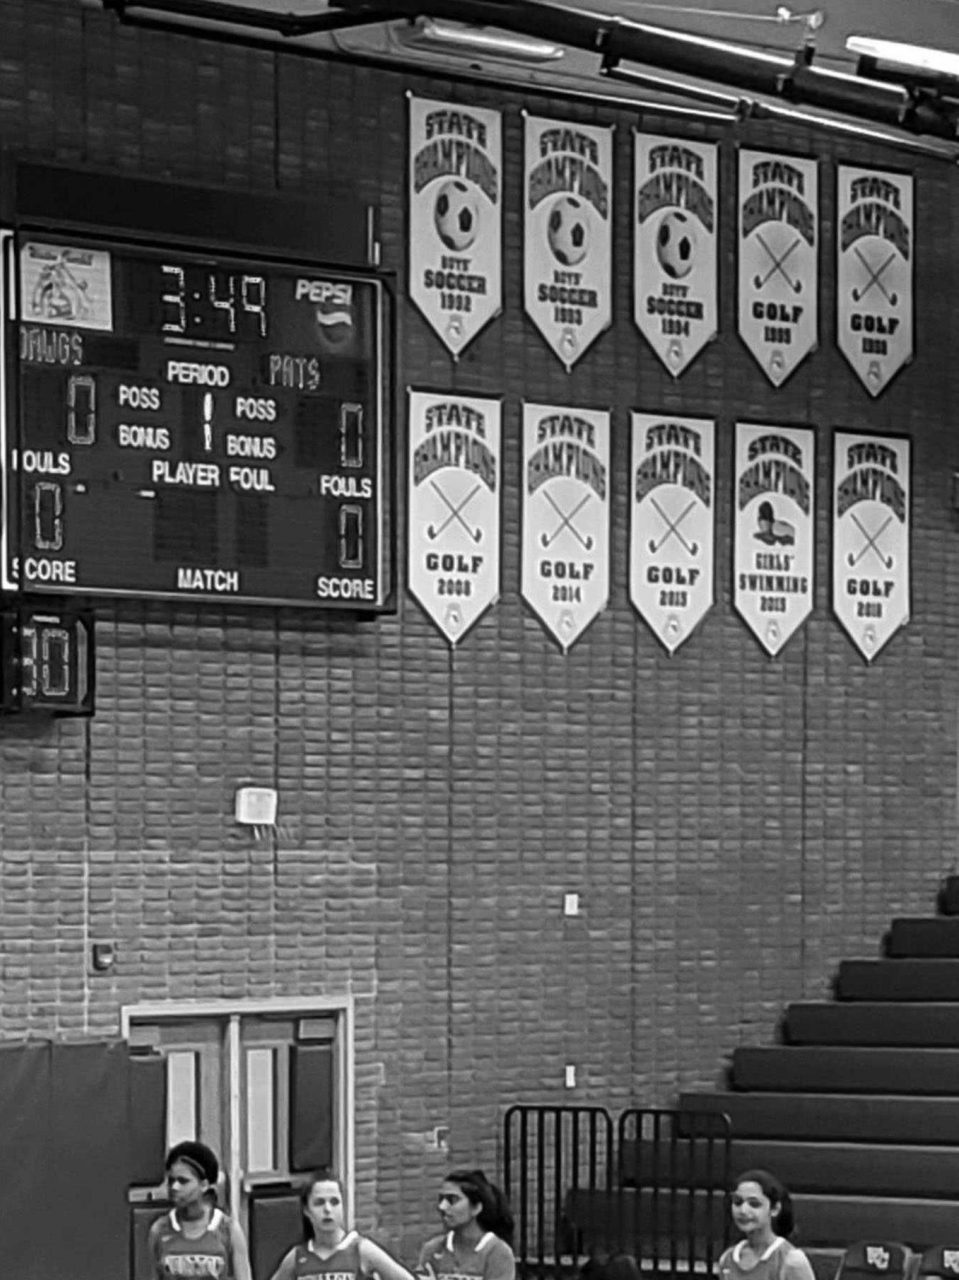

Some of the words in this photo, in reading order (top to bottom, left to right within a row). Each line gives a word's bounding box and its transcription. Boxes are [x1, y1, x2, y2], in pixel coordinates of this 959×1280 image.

[295, 279, 353, 306] PEPSI
[424, 269, 486, 294] SOCCER
[161, 264, 267, 337] 3:49
[537, 283, 598, 308] SOCCER
[646, 296, 704, 320] SOCCER
[752, 302, 803, 324] GOLF
[850, 314, 899, 336] GOLF
[167, 360, 230, 388] PERIOD
[270, 354, 320, 390] PATS
[119, 384, 160, 409] POSS
[236, 397, 277, 421] POSS
[425, 403, 486, 439] STATE
[537, 414, 596, 450] STATE
[119, 424, 170, 450] BONUS
[226, 434, 276, 460] BONUS
[646, 424, 702, 458] STATE
[152, 460, 219, 487] PLAYER
[229, 466, 275, 492] FOUL
[320, 475, 372, 498] FOULS
[426, 553, 483, 574] GOLF
[540, 560, 594, 580] GOLF
[647, 566, 700, 586] GOLF
[177, 568, 239, 592] MATCH
[318, 577, 374, 600] SCORE
[739, 574, 808, 594] SWIMMING
[847, 579, 894, 598] GOLF
